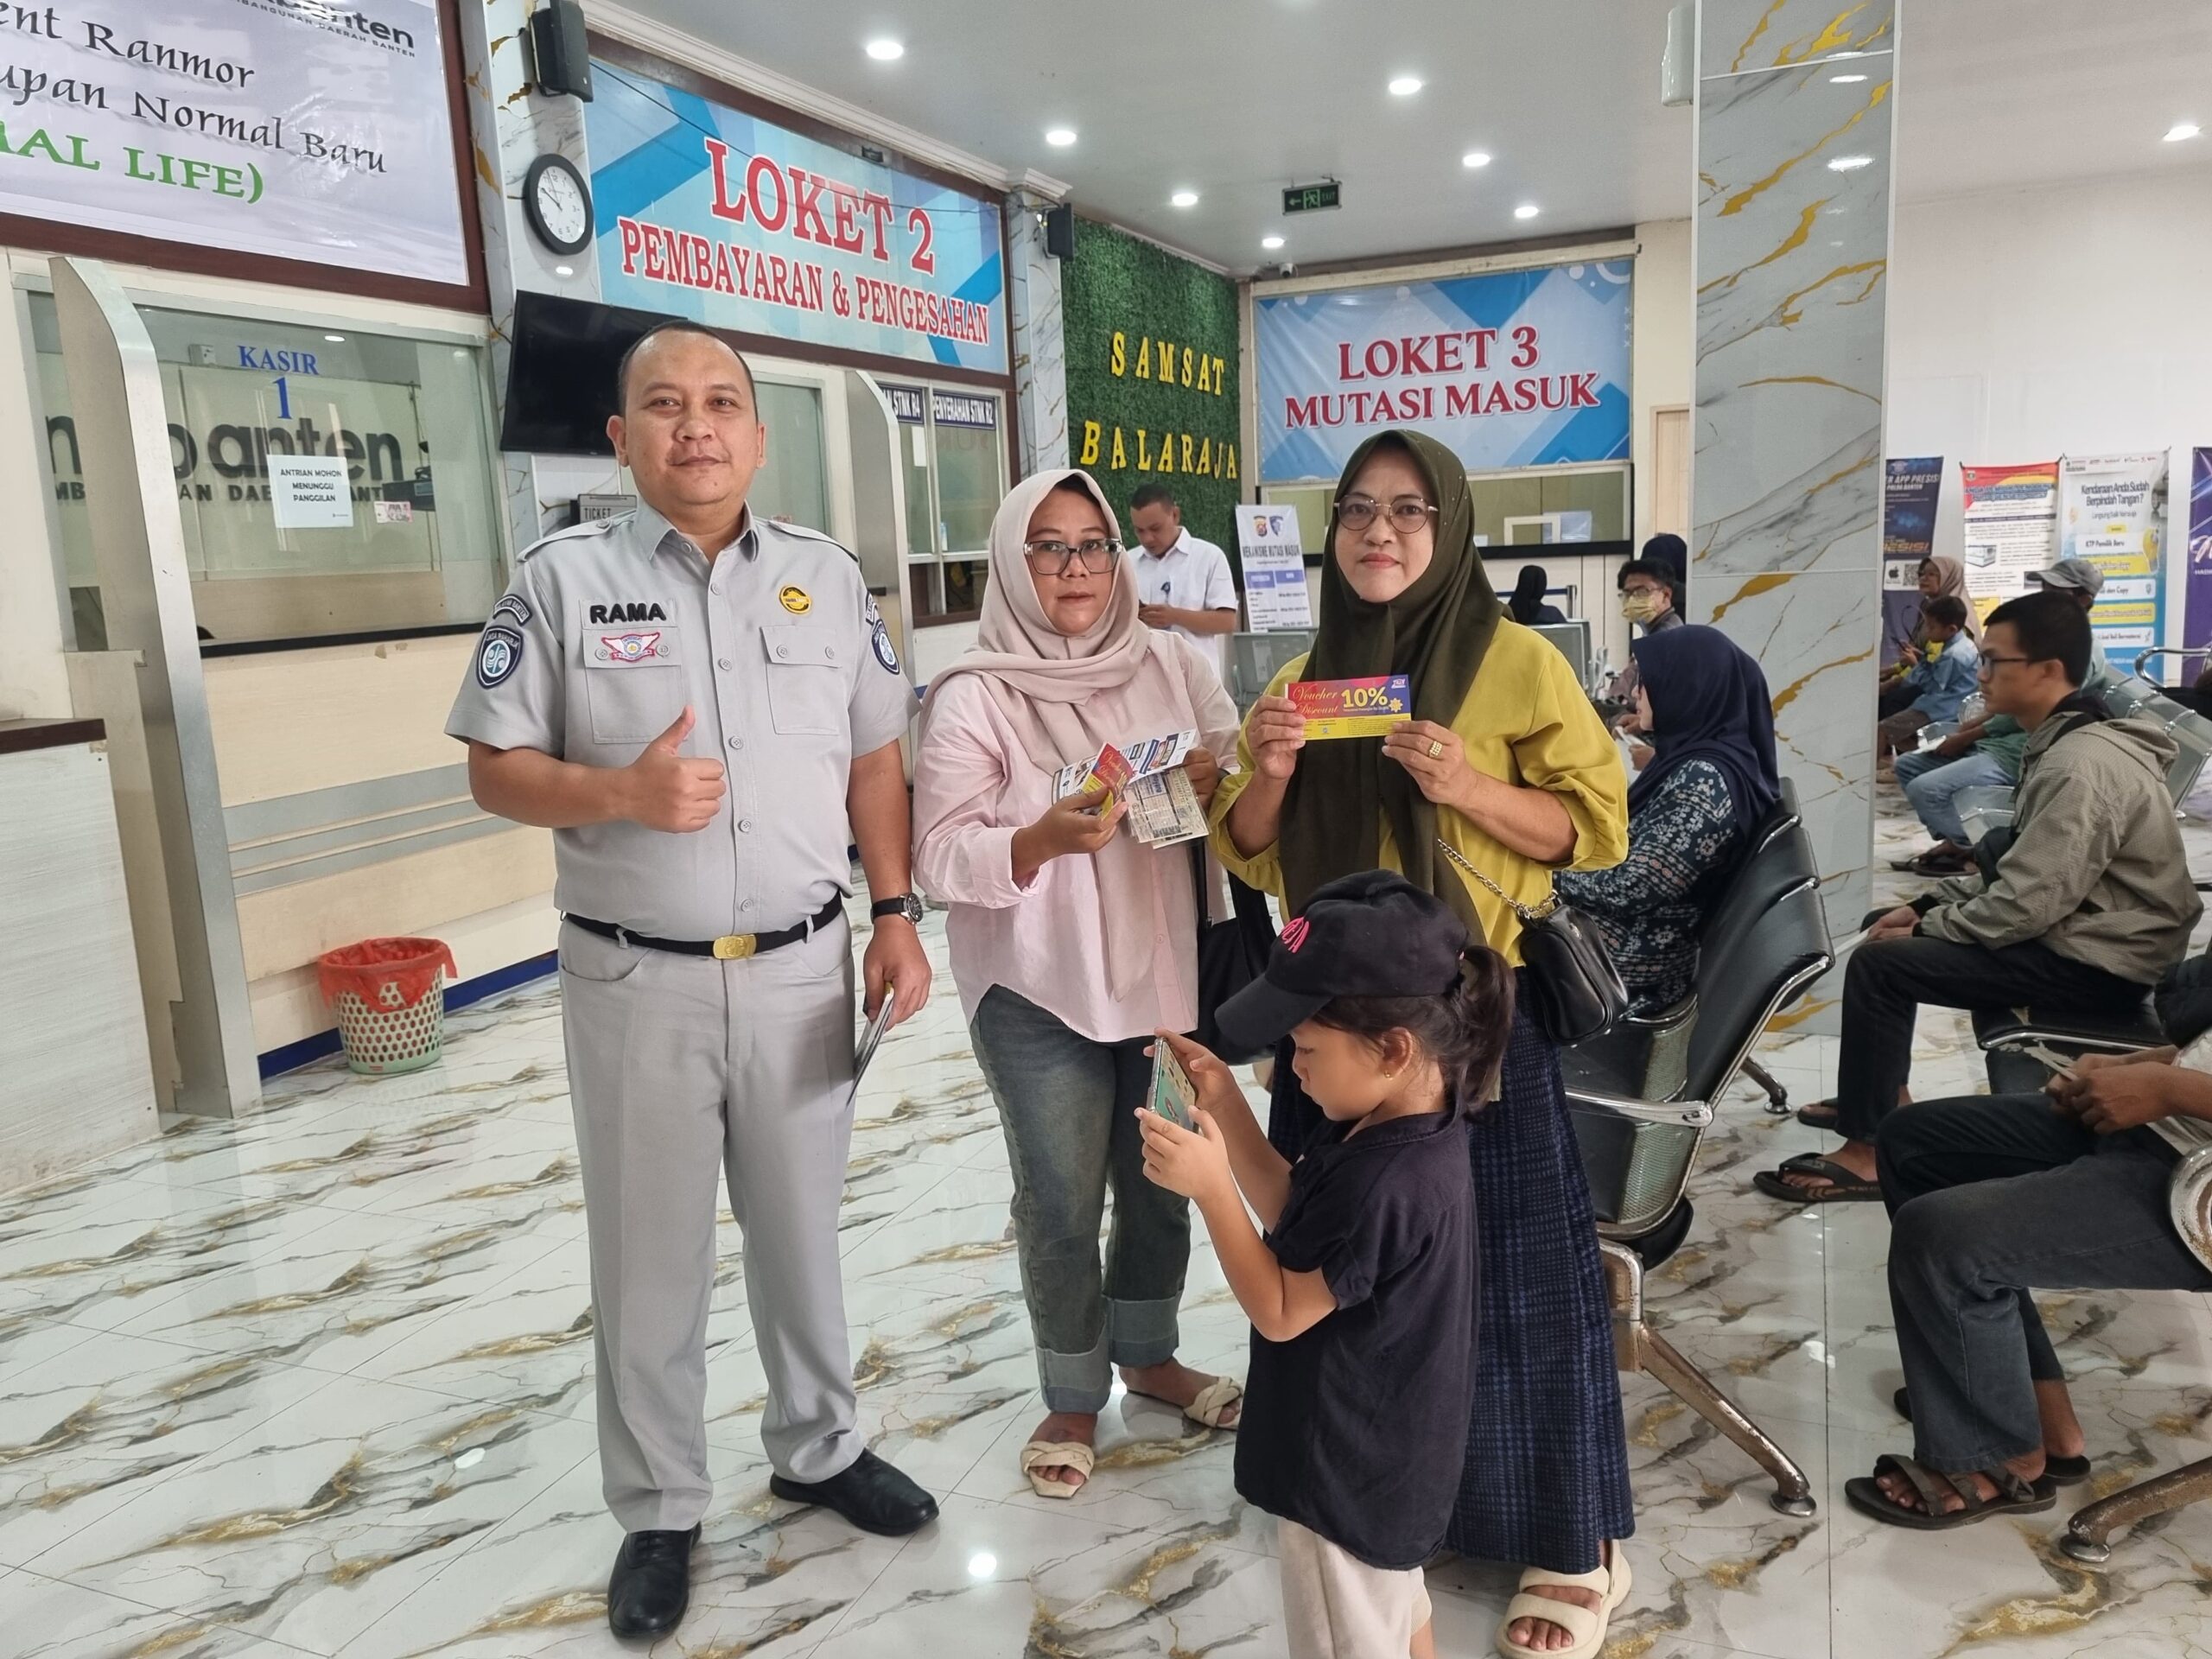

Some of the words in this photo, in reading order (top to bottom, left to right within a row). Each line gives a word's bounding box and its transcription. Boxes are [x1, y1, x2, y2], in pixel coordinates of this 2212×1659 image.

[81, 20, 255, 87] Ranmor
[131, 91, 285, 149] Normal
[299, 131, 388, 174] Baru
[123, 146, 264, 205] LIFE)
[704, 137, 893, 261] LOKET
[908, 207, 935, 275] 2
[618, 218, 825, 313] PEMBAYARAN
[832, 270, 850, 318] &
[856, 275, 989, 346] PENGESAHAN
[238, 346, 320, 375] KASIR
[1111, 331, 1224, 397] SAMSAT
[1338, 327, 1497, 383] LOKET
[1510, 325, 1541, 368] 3
[272, 377, 292, 420] 1
[1284, 388, 1434, 429] MUTASI
[1444, 372, 1602, 418] MASUK
[1080, 420, 1237, 480] BALARAJA
[584, 508, 612, 520] TICKET
[589, 602, 667, 624] RAMA
[1293, 683, 1338, 702] Voucher
[1341, 686, 1389, 709] 10%
[1296, 701, 1339, 715] Discount
